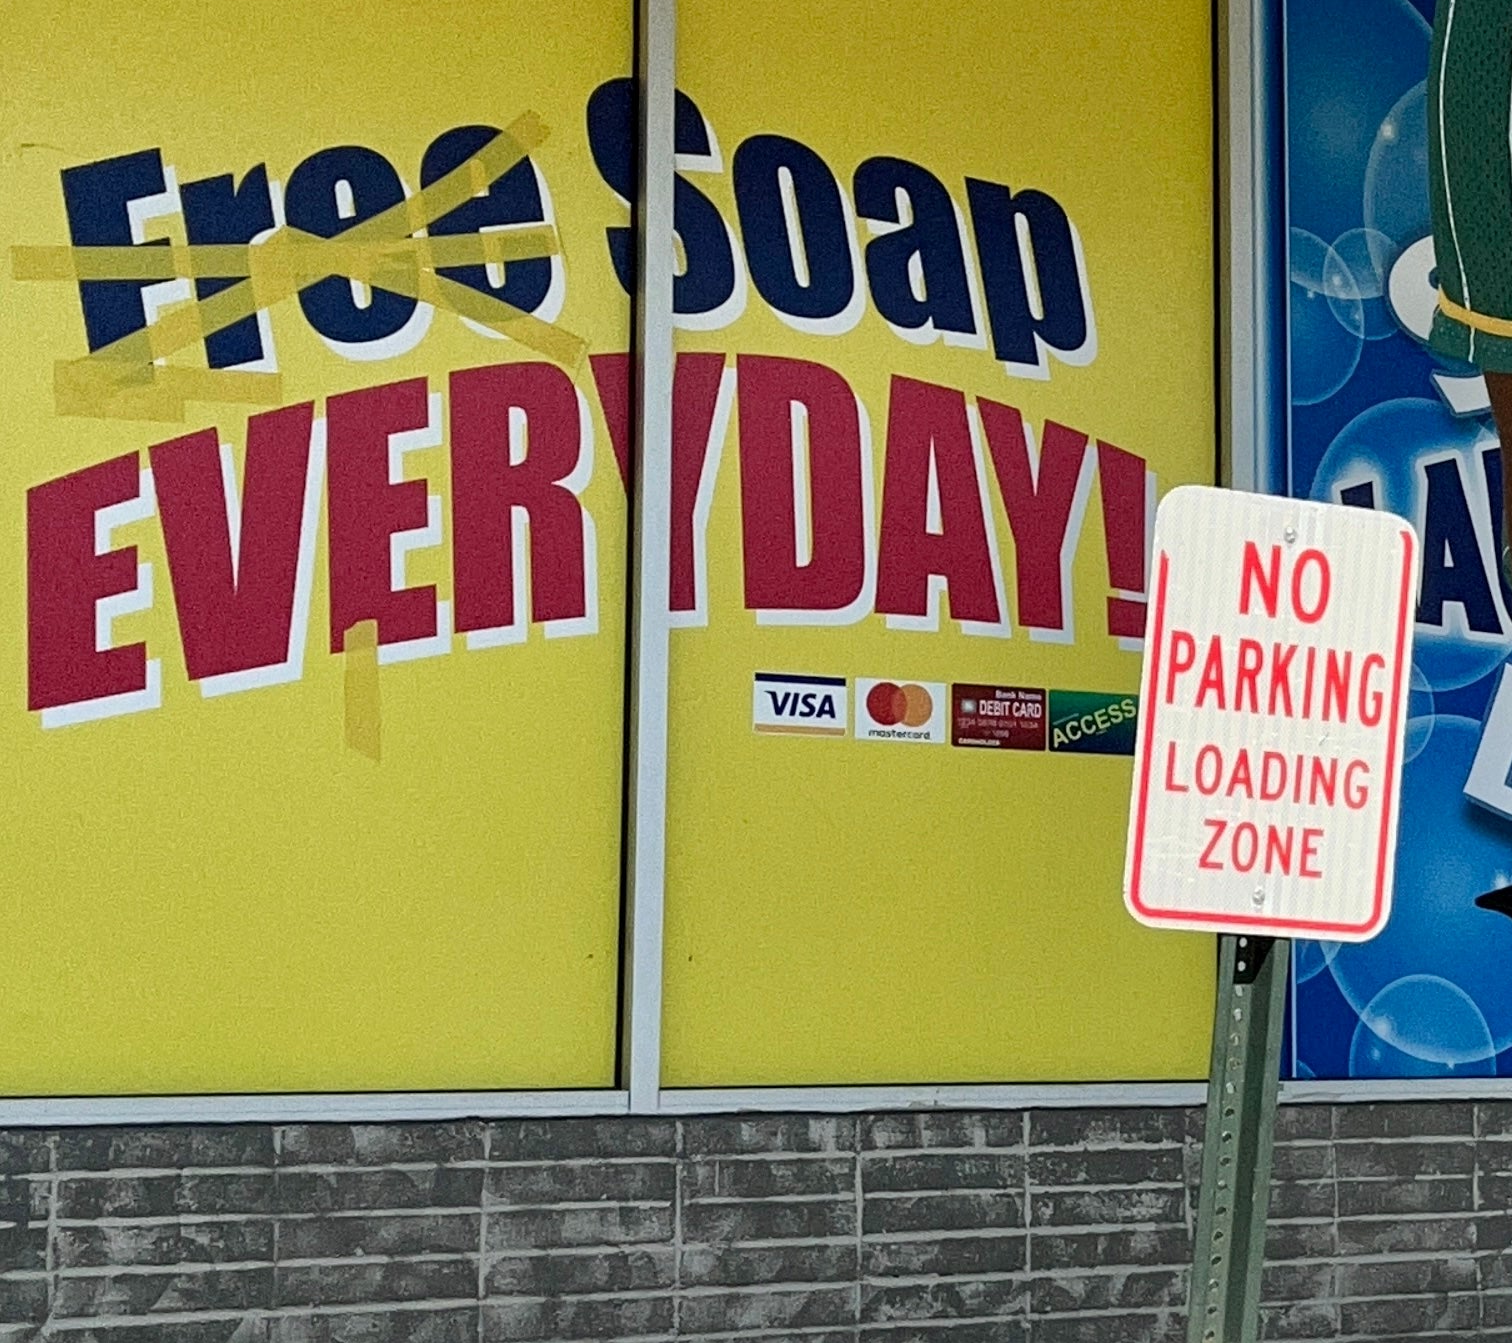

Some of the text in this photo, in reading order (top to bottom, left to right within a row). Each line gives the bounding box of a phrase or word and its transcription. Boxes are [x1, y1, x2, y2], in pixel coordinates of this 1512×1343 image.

[60, 76, 1096, 376] Free Soap
[27, 351, 1150, 722] EVERYDAY!
[1238, 540, 1331, 624] NO
[763, 690, 836, 719] VISA
[979, 699, 1042, 718] DEBIT CARD
[1165, 630, 1386, 728] PARKING
[868, 729, 931, 741] mastercard
[1053, 698, 1137, 749] ACCESS
[1164, 741, 1370, 810] LOADING
[1199, 819, 1325, 879] ZONE
